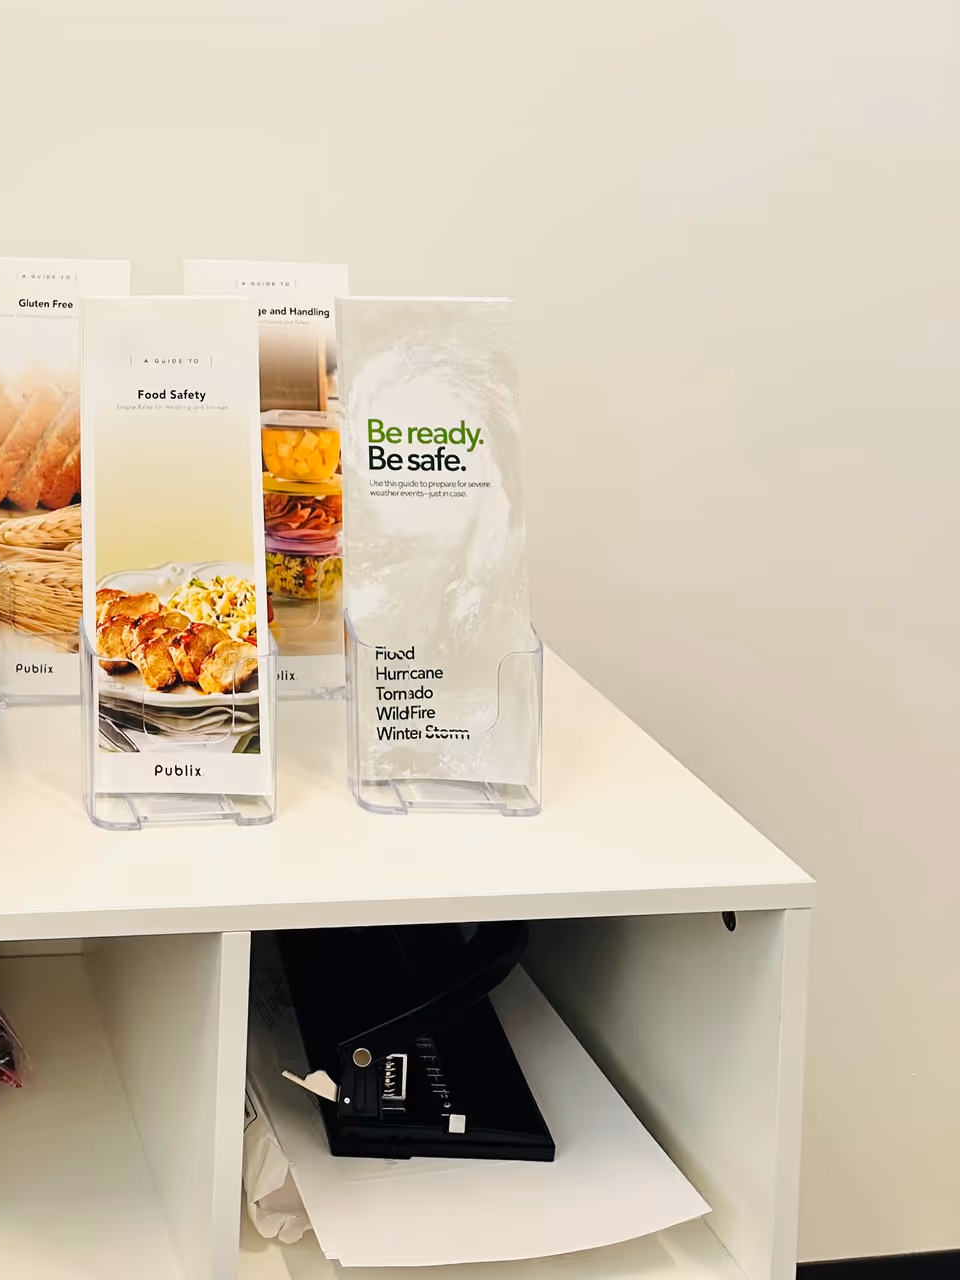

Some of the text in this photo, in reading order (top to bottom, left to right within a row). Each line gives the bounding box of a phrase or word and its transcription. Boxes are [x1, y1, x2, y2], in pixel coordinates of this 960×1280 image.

[18, 298, 72, 308] Gluten Free
[270, 307, 286, 315] and
[289, 307, 329, 318] Handling
[138, 389, 205, 401] Food Safety
[368, 418, 484, 452] Be ready.
[368, 446, 466, 472] Be safe.
[384, 480, 397, 488] this
[398, 480, 418, 489] guide
[428, 481, 456, 490] prepare
[375, 646, 415, 660] Flood
[15, 663, 54, 674] Publix
[376, 666, 444, 681] Hurrcane
[376, 685, 434, 701] Tornado
[425, 725, 470, 740] Storm
[154, 764, 203, 777] Publix
